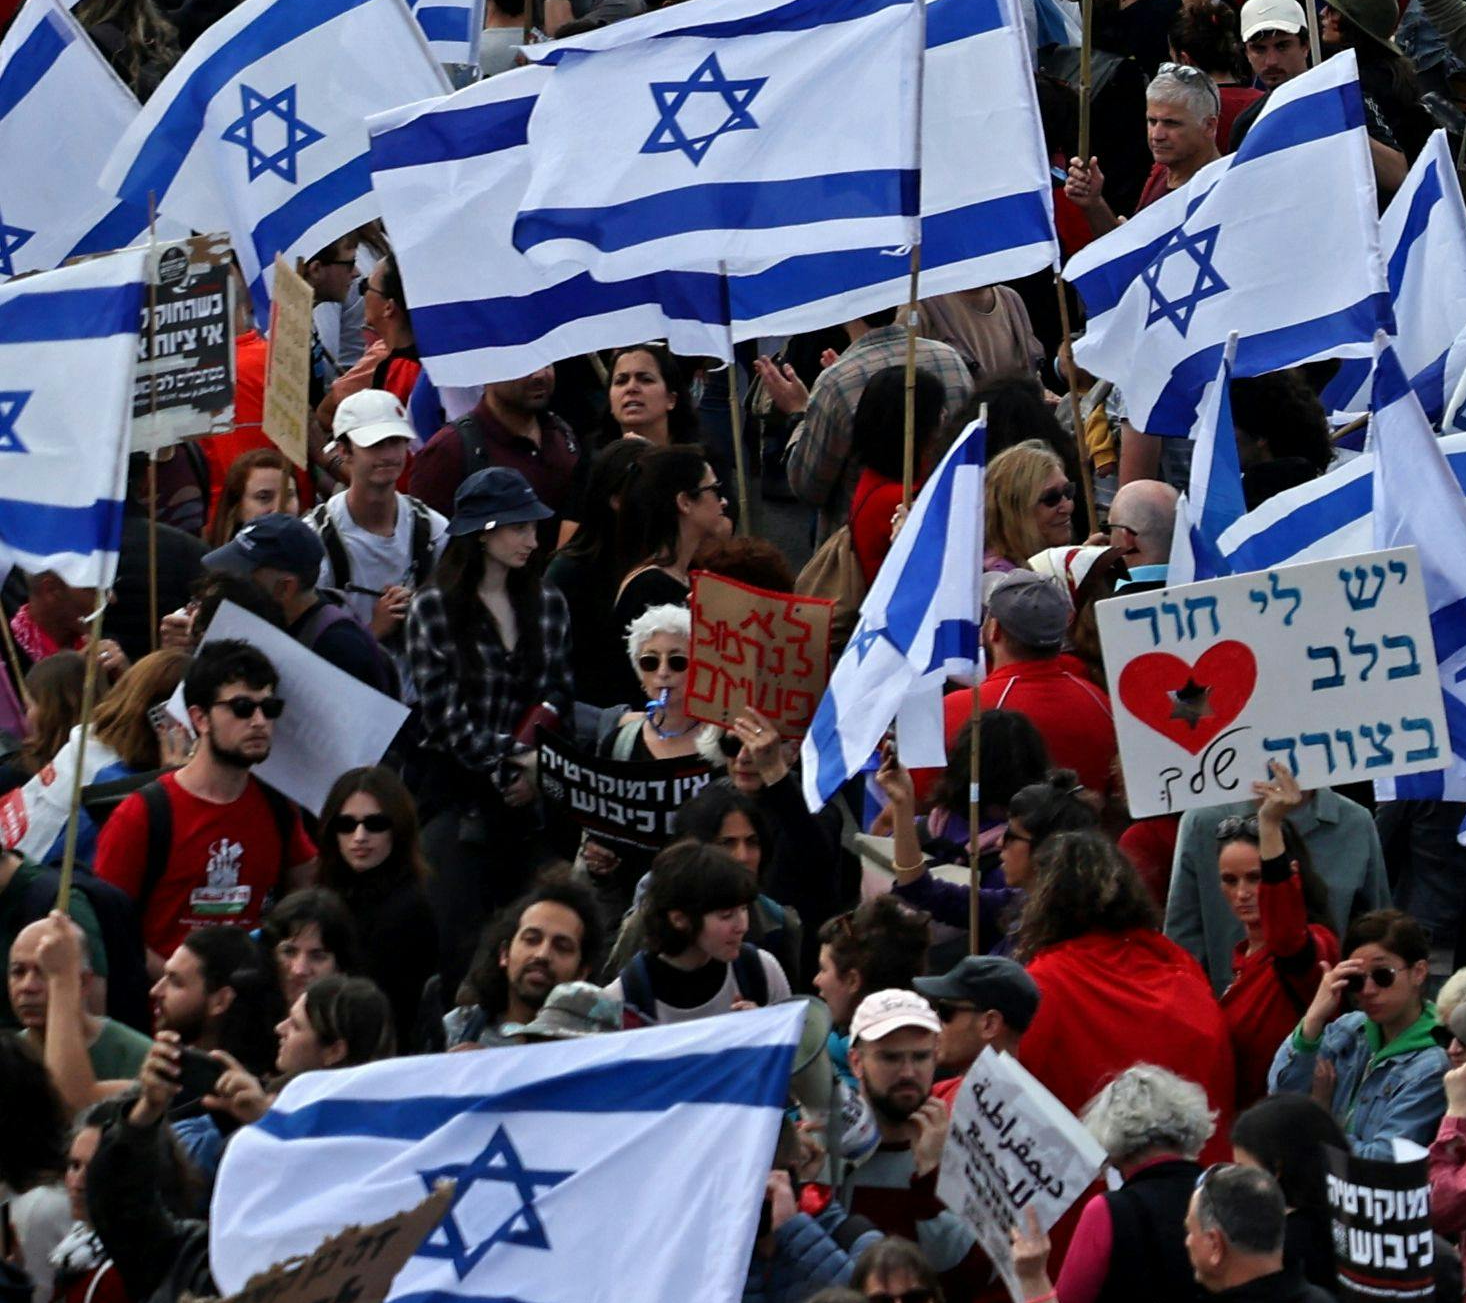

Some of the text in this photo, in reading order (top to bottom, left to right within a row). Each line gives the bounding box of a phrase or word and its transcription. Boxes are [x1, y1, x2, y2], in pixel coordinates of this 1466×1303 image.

[1251, 575, 1301, 626] לי
[1340, 560, 1407, 610] יש
[1308, 628, 1421, 691] בלב
[541, 742, 711, 807] אין דמוקרטיה
[1263, 716, 1439, 782] בצורה
[571, 788, 655, 834] כיבוש
[1348, 1227, 1436, 1270] כיבוש
